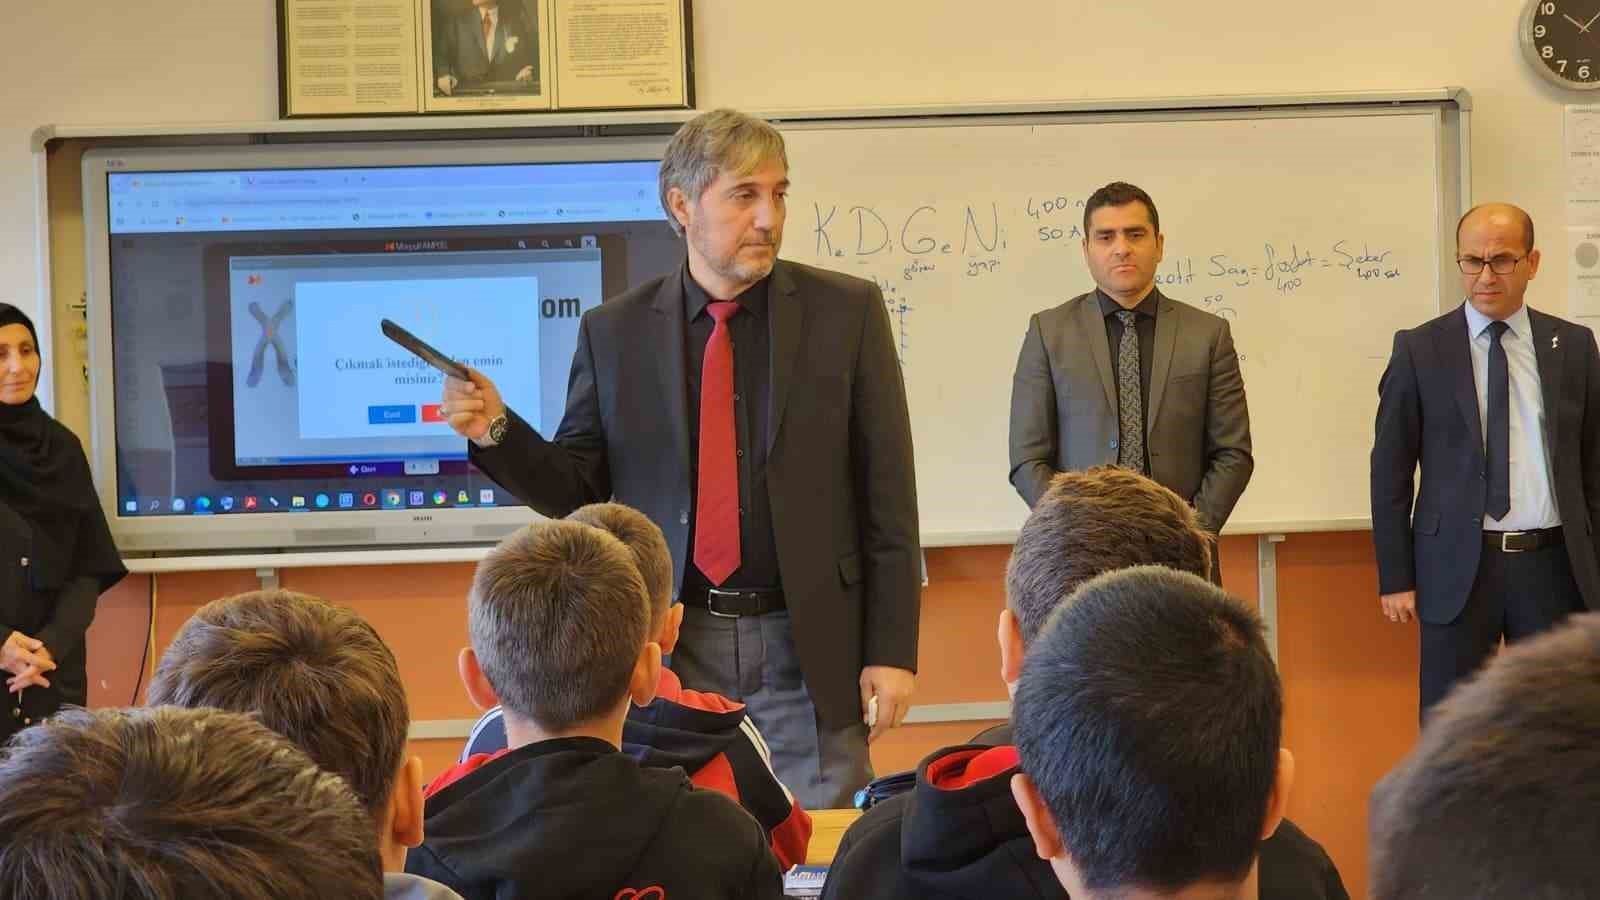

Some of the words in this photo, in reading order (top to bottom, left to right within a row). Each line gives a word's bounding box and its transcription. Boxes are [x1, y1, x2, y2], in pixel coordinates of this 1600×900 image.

[1541, 2, 1555, 15] 10
[1535, 25, 1546, 38] 9
[1542, 46, 1554, 58] 8
[1556, 60, 1568, 73] 7
[1578, 66, 1590, 79] 6
[1027, 196, 1067, 219] 400
[541, 298, 581, 319] om
